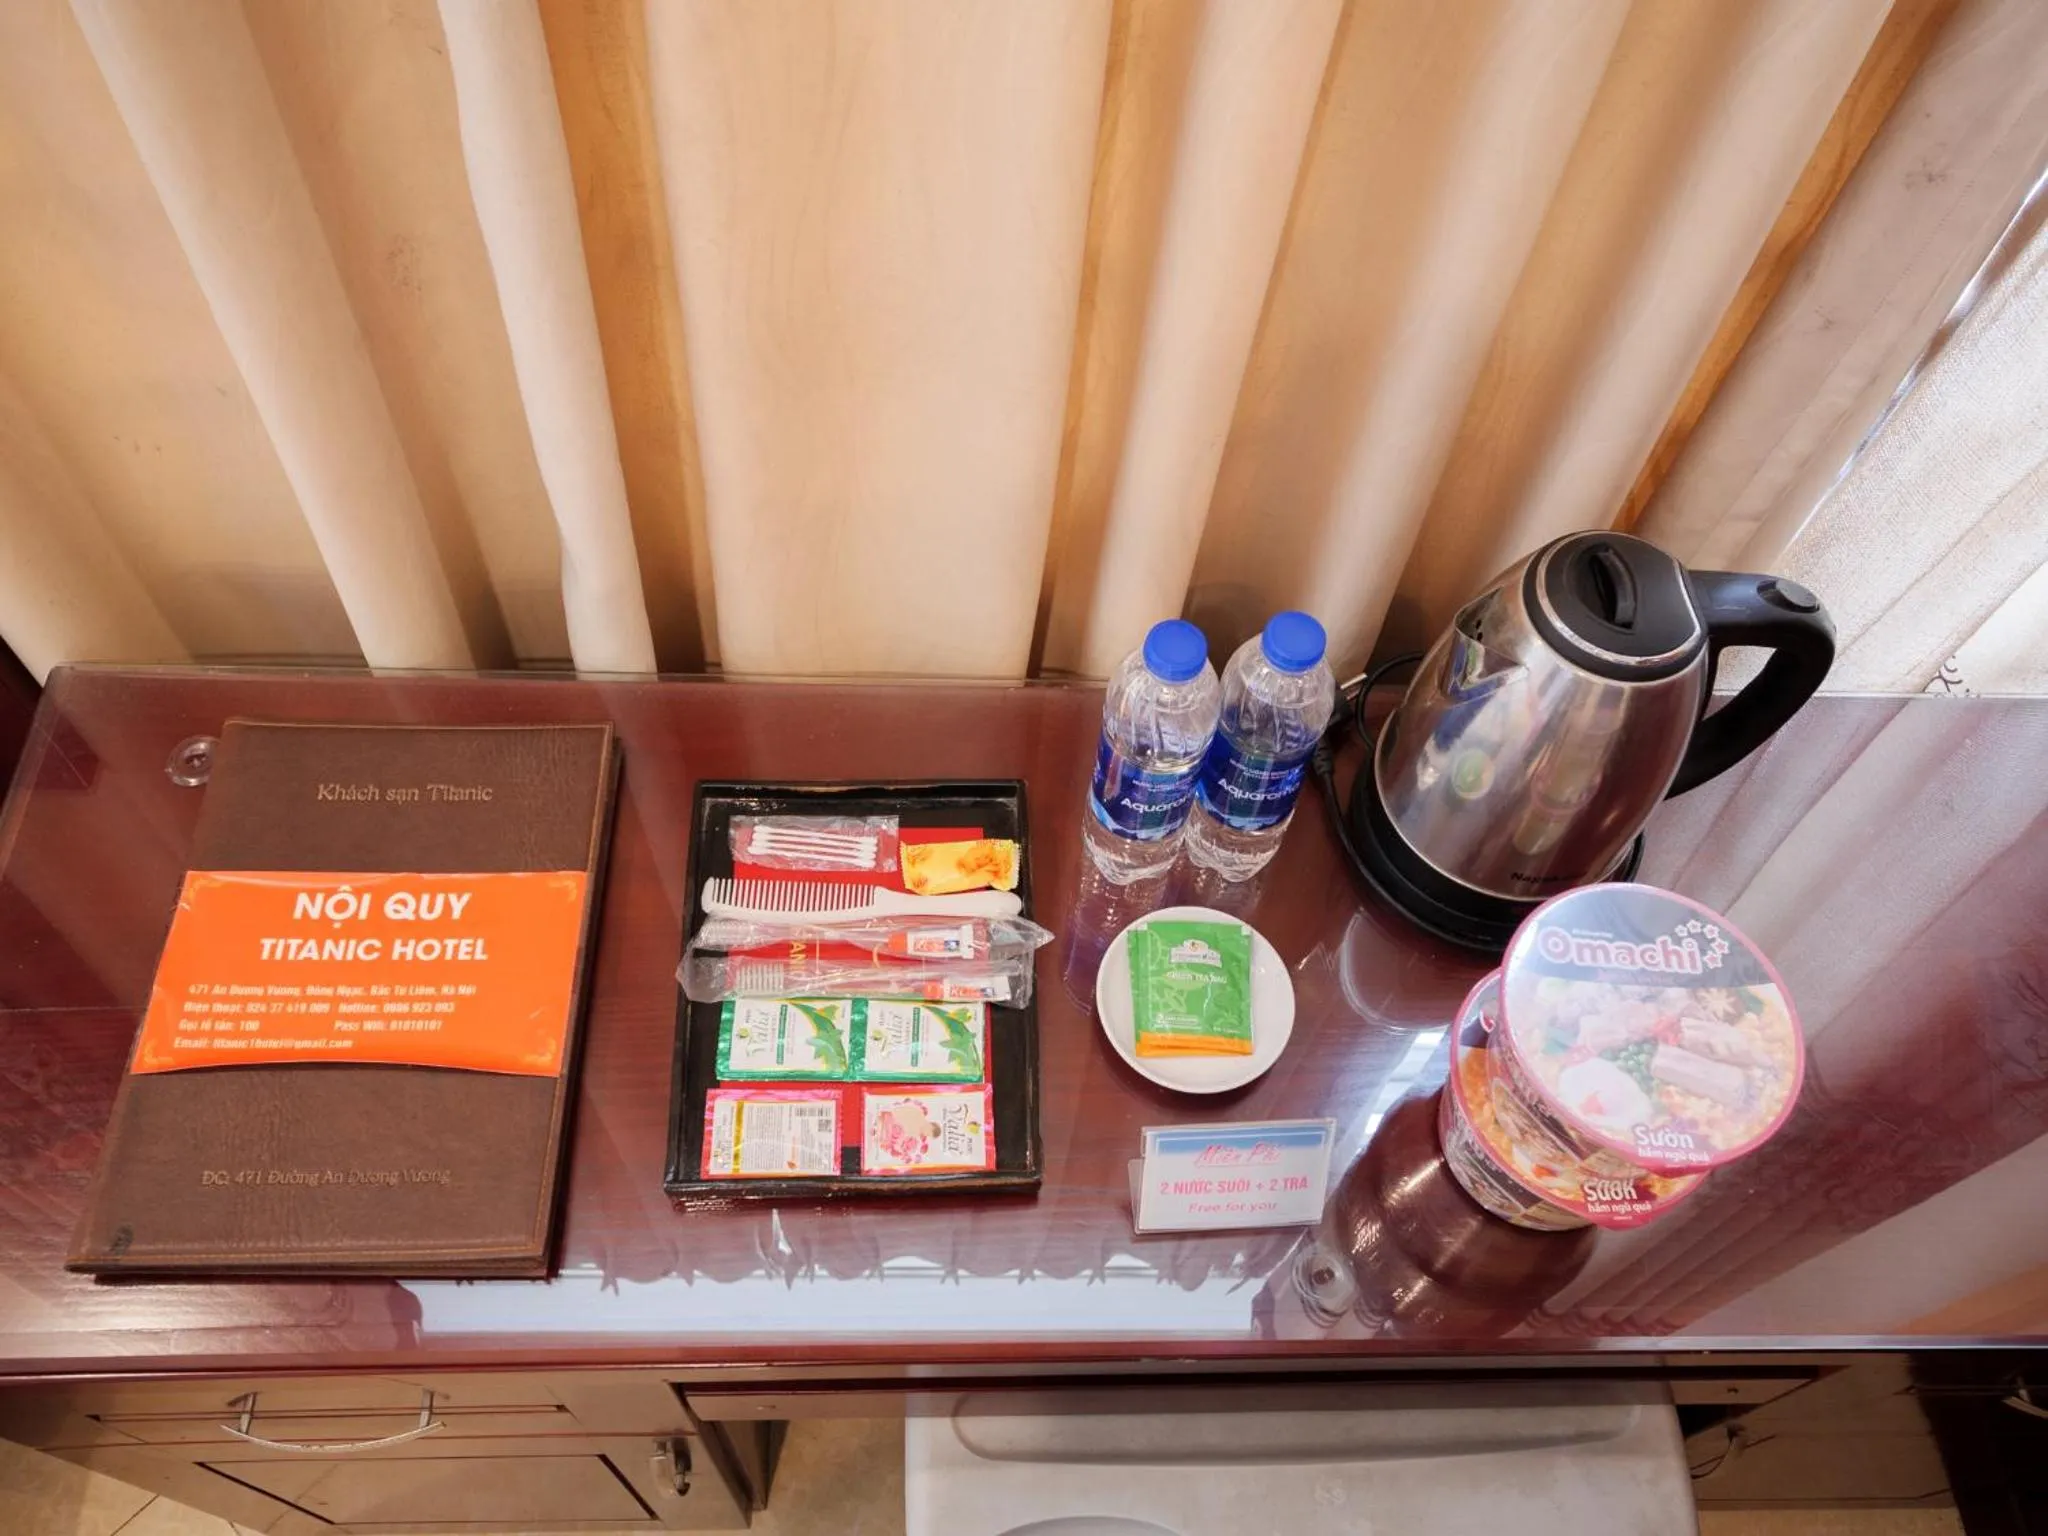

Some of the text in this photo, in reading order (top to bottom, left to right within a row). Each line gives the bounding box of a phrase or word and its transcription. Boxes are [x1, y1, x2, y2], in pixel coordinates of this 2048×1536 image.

[317, 782, 494, 805] Khách sạn Titanic
[292, 885, 473, 929] NỘI QUY
[260, 938, 489, 961] TITANIC HOTEL
[1538, 926, 1702, 974] Omachi
[269, 1001, 284, 1014] 37
[1634, 1123, 1695, 1149] Sườn
[234, 1170, 262, 1184] 471
[322, 1170, 343, 1184] An
[1160, 1181, 1170, 1195] 2
[1269, 1178, 1280, 1192] 2
[1188, 1202, 1278, 1214] Free for you
